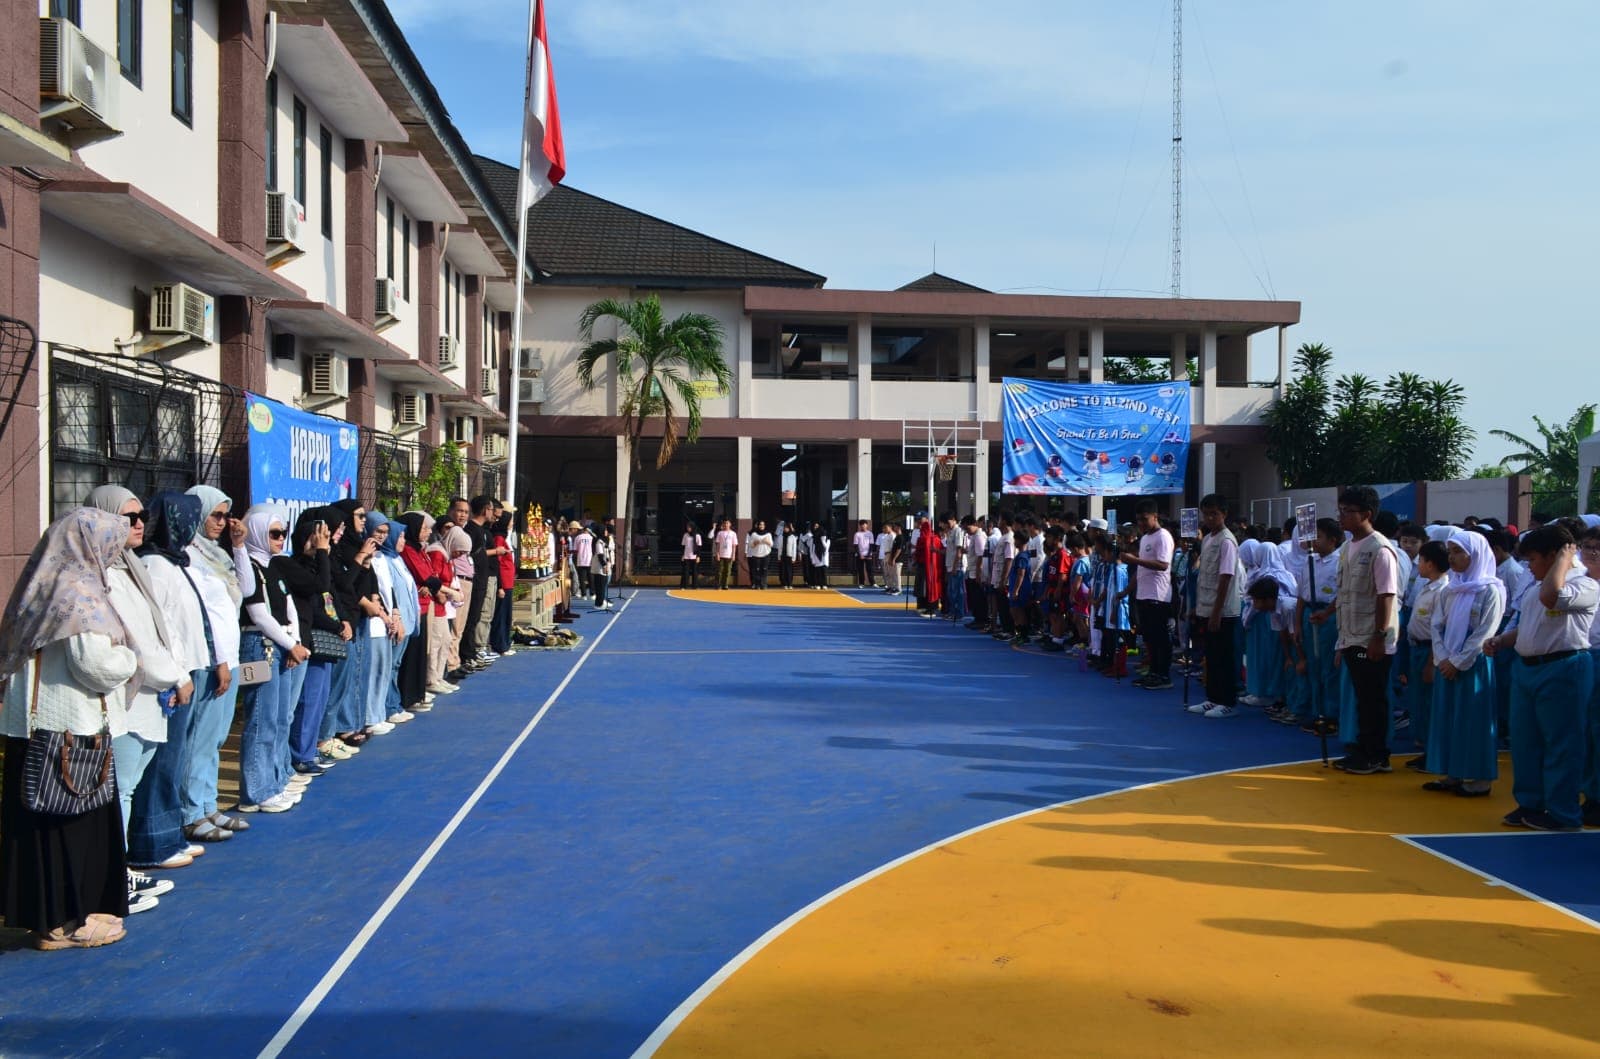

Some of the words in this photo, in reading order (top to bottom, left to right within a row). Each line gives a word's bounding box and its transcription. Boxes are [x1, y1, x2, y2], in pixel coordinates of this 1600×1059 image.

[1017, 396, 1078, 421] WELCOME
[1083, 395, 1100, 406] TO
[1150, 406, 1181, 426] FEST
[1087, 428, 1098, 439] To
[1098, 428, 1109, 440] Be
[1111, 428, 1119, 439] A
[1120, 428, 1142, 440] Star
[291, 426, 331, 482] HAPPY
